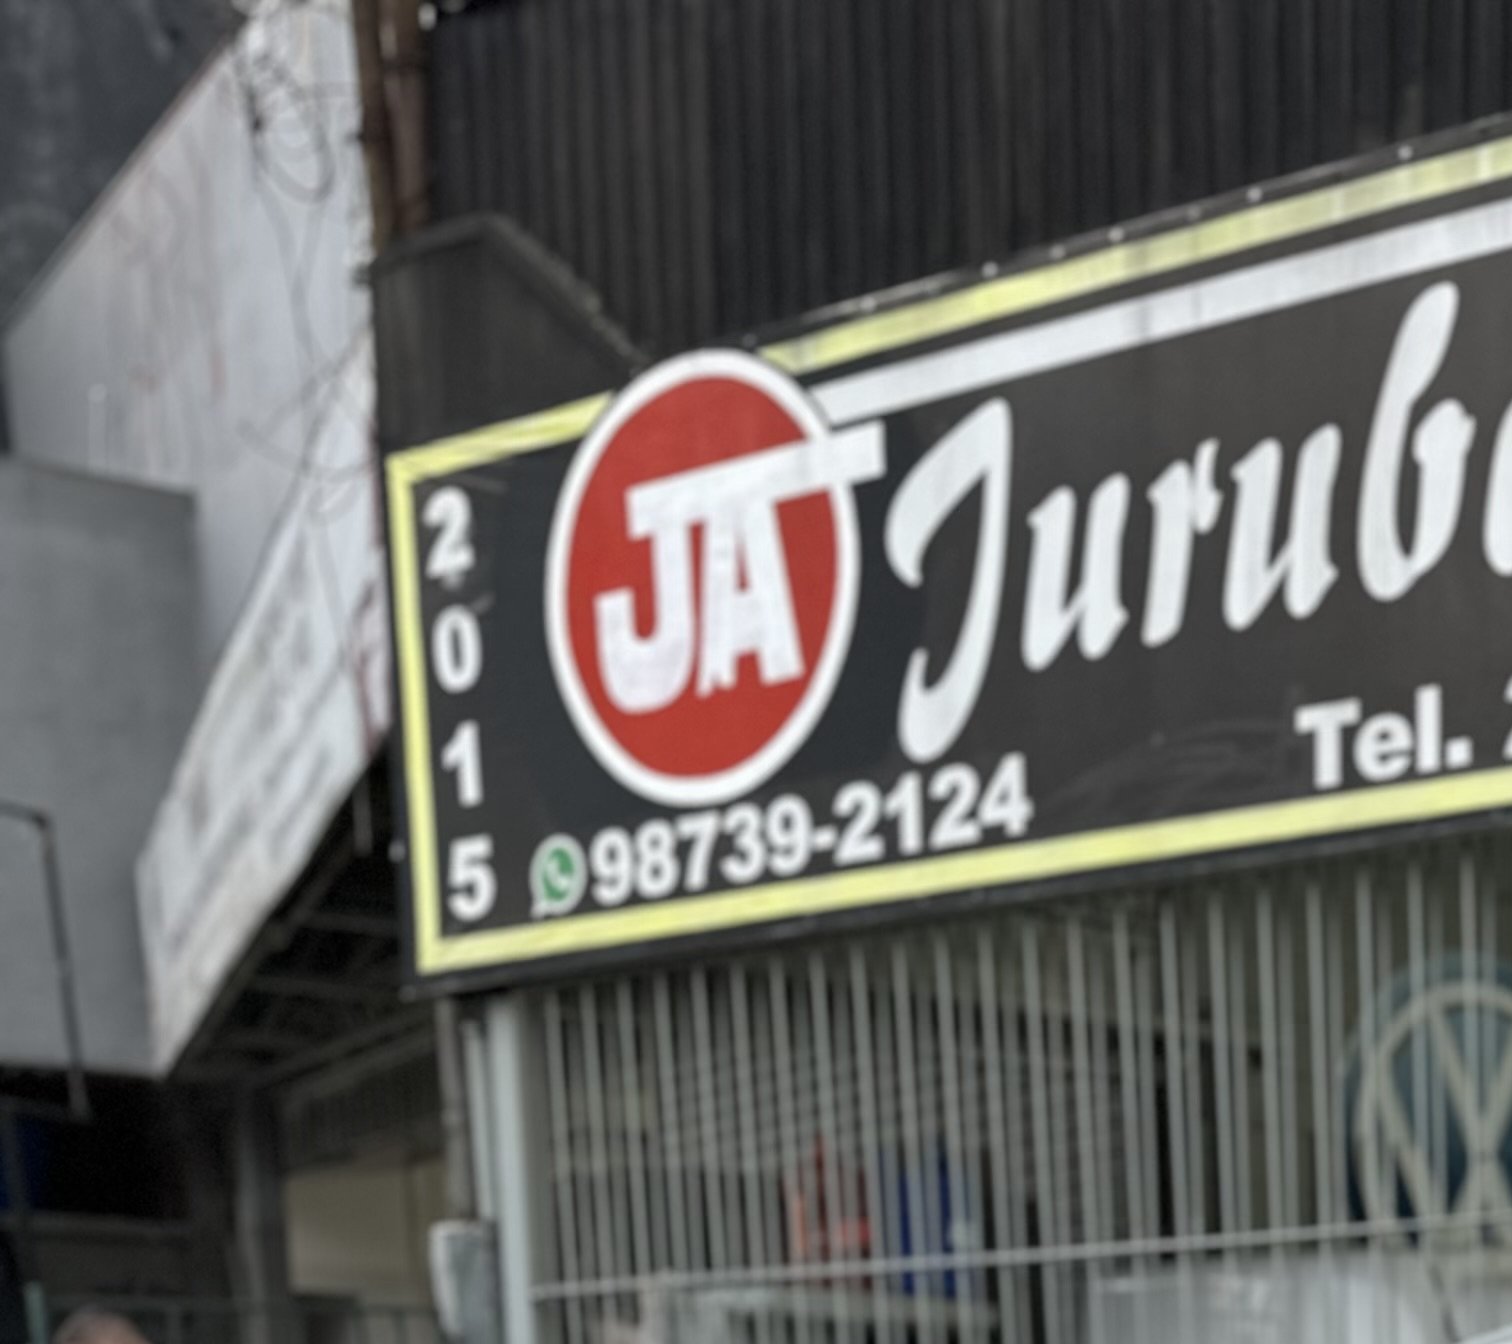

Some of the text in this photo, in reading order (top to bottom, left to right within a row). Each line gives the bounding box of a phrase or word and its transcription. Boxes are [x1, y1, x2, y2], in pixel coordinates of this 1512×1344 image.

[595, 420, 886, 714] JA
[1295, 684, 1472, 790] Tel.
[590, 751, 1033, 905] 98739-2124
